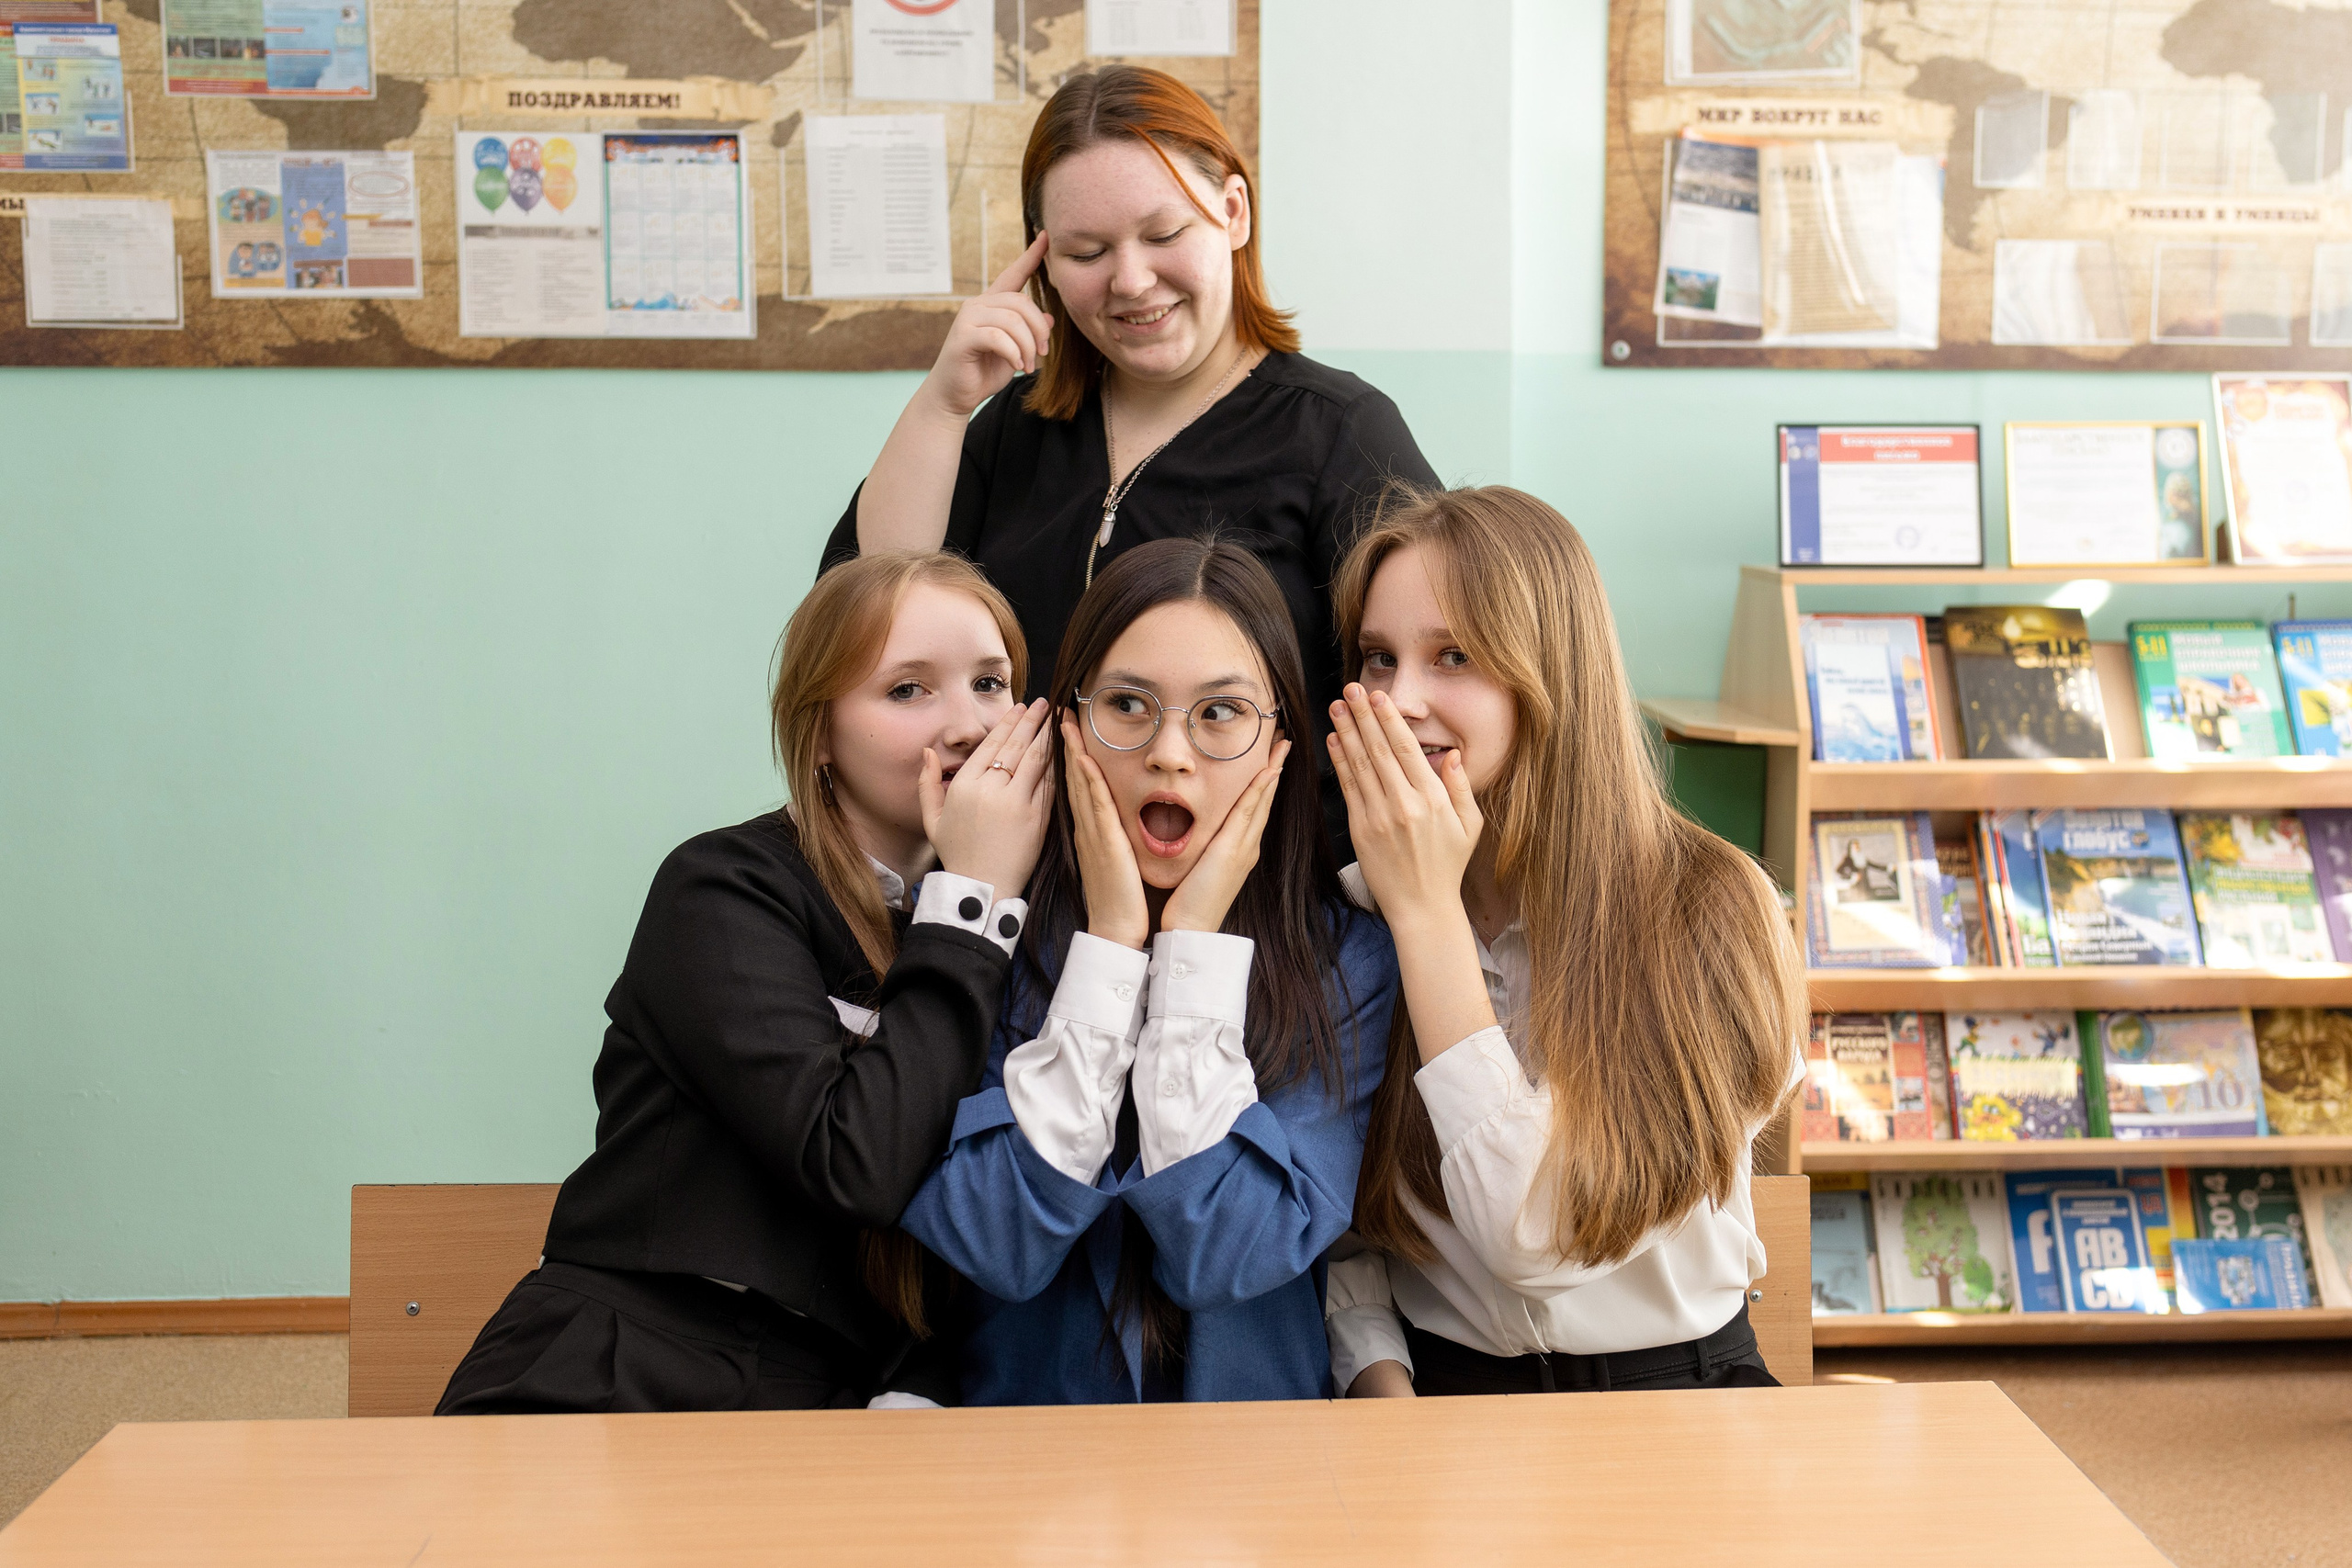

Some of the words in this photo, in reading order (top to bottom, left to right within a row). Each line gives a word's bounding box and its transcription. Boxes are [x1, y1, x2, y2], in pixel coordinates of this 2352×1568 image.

[508, 92, 680, 109] ПОЗДРАВЛЯЕМ!
[1699, 107, 1741, 123] МИР
[1751, 108, 1829, 124] ВОКРУГ
[1839, 110, 1883, 125] НАС
[2197, 1079, 2245, 1109] 10
[2075, 1227, 2128, 1268] AB
